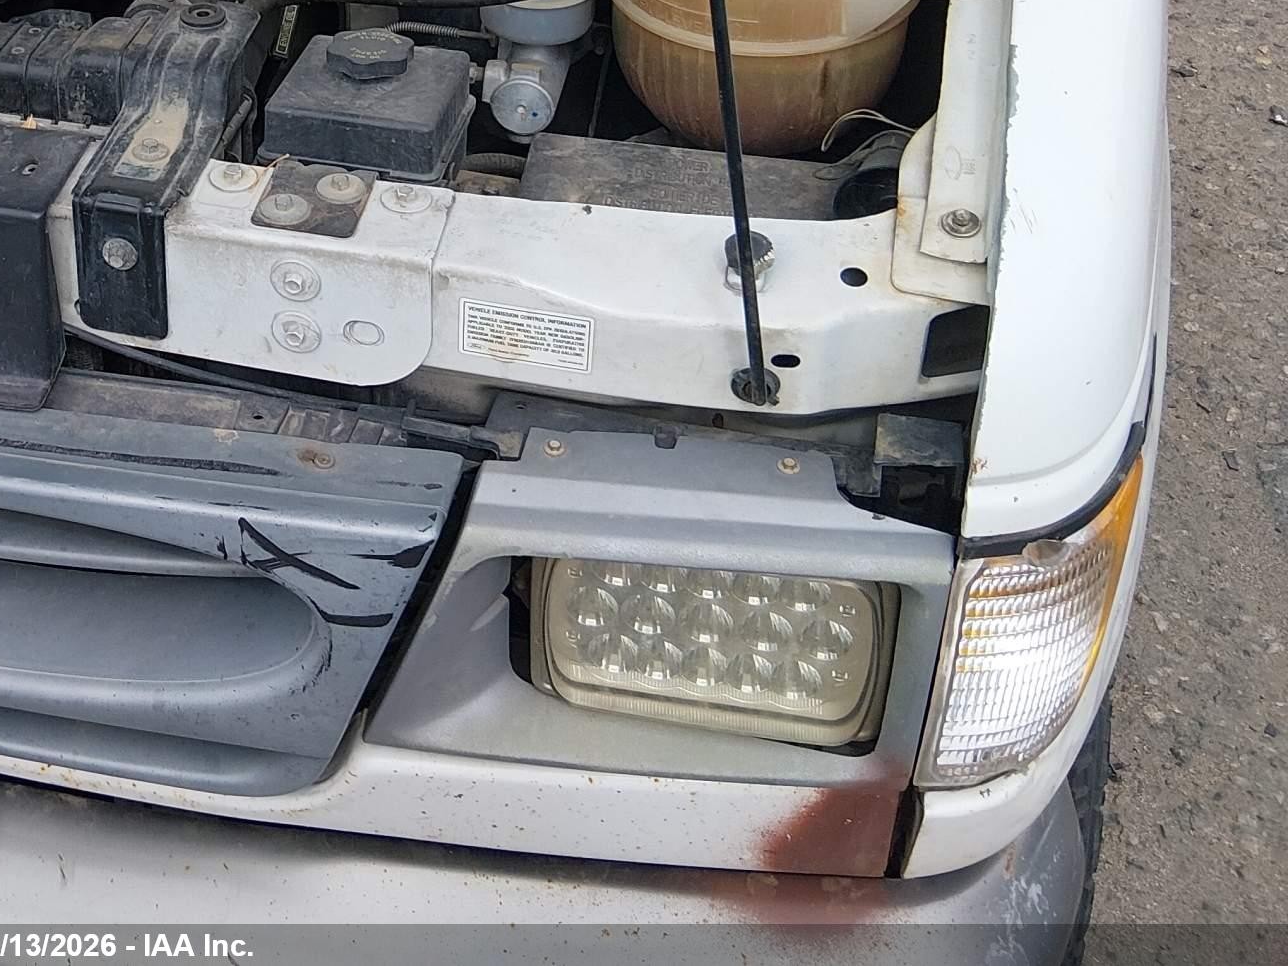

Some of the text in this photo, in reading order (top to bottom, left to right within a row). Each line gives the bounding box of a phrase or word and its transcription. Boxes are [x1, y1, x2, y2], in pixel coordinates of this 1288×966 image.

[468, 306, 586, 329] VEHICLE EMISSION CONTROL INFORMATION
